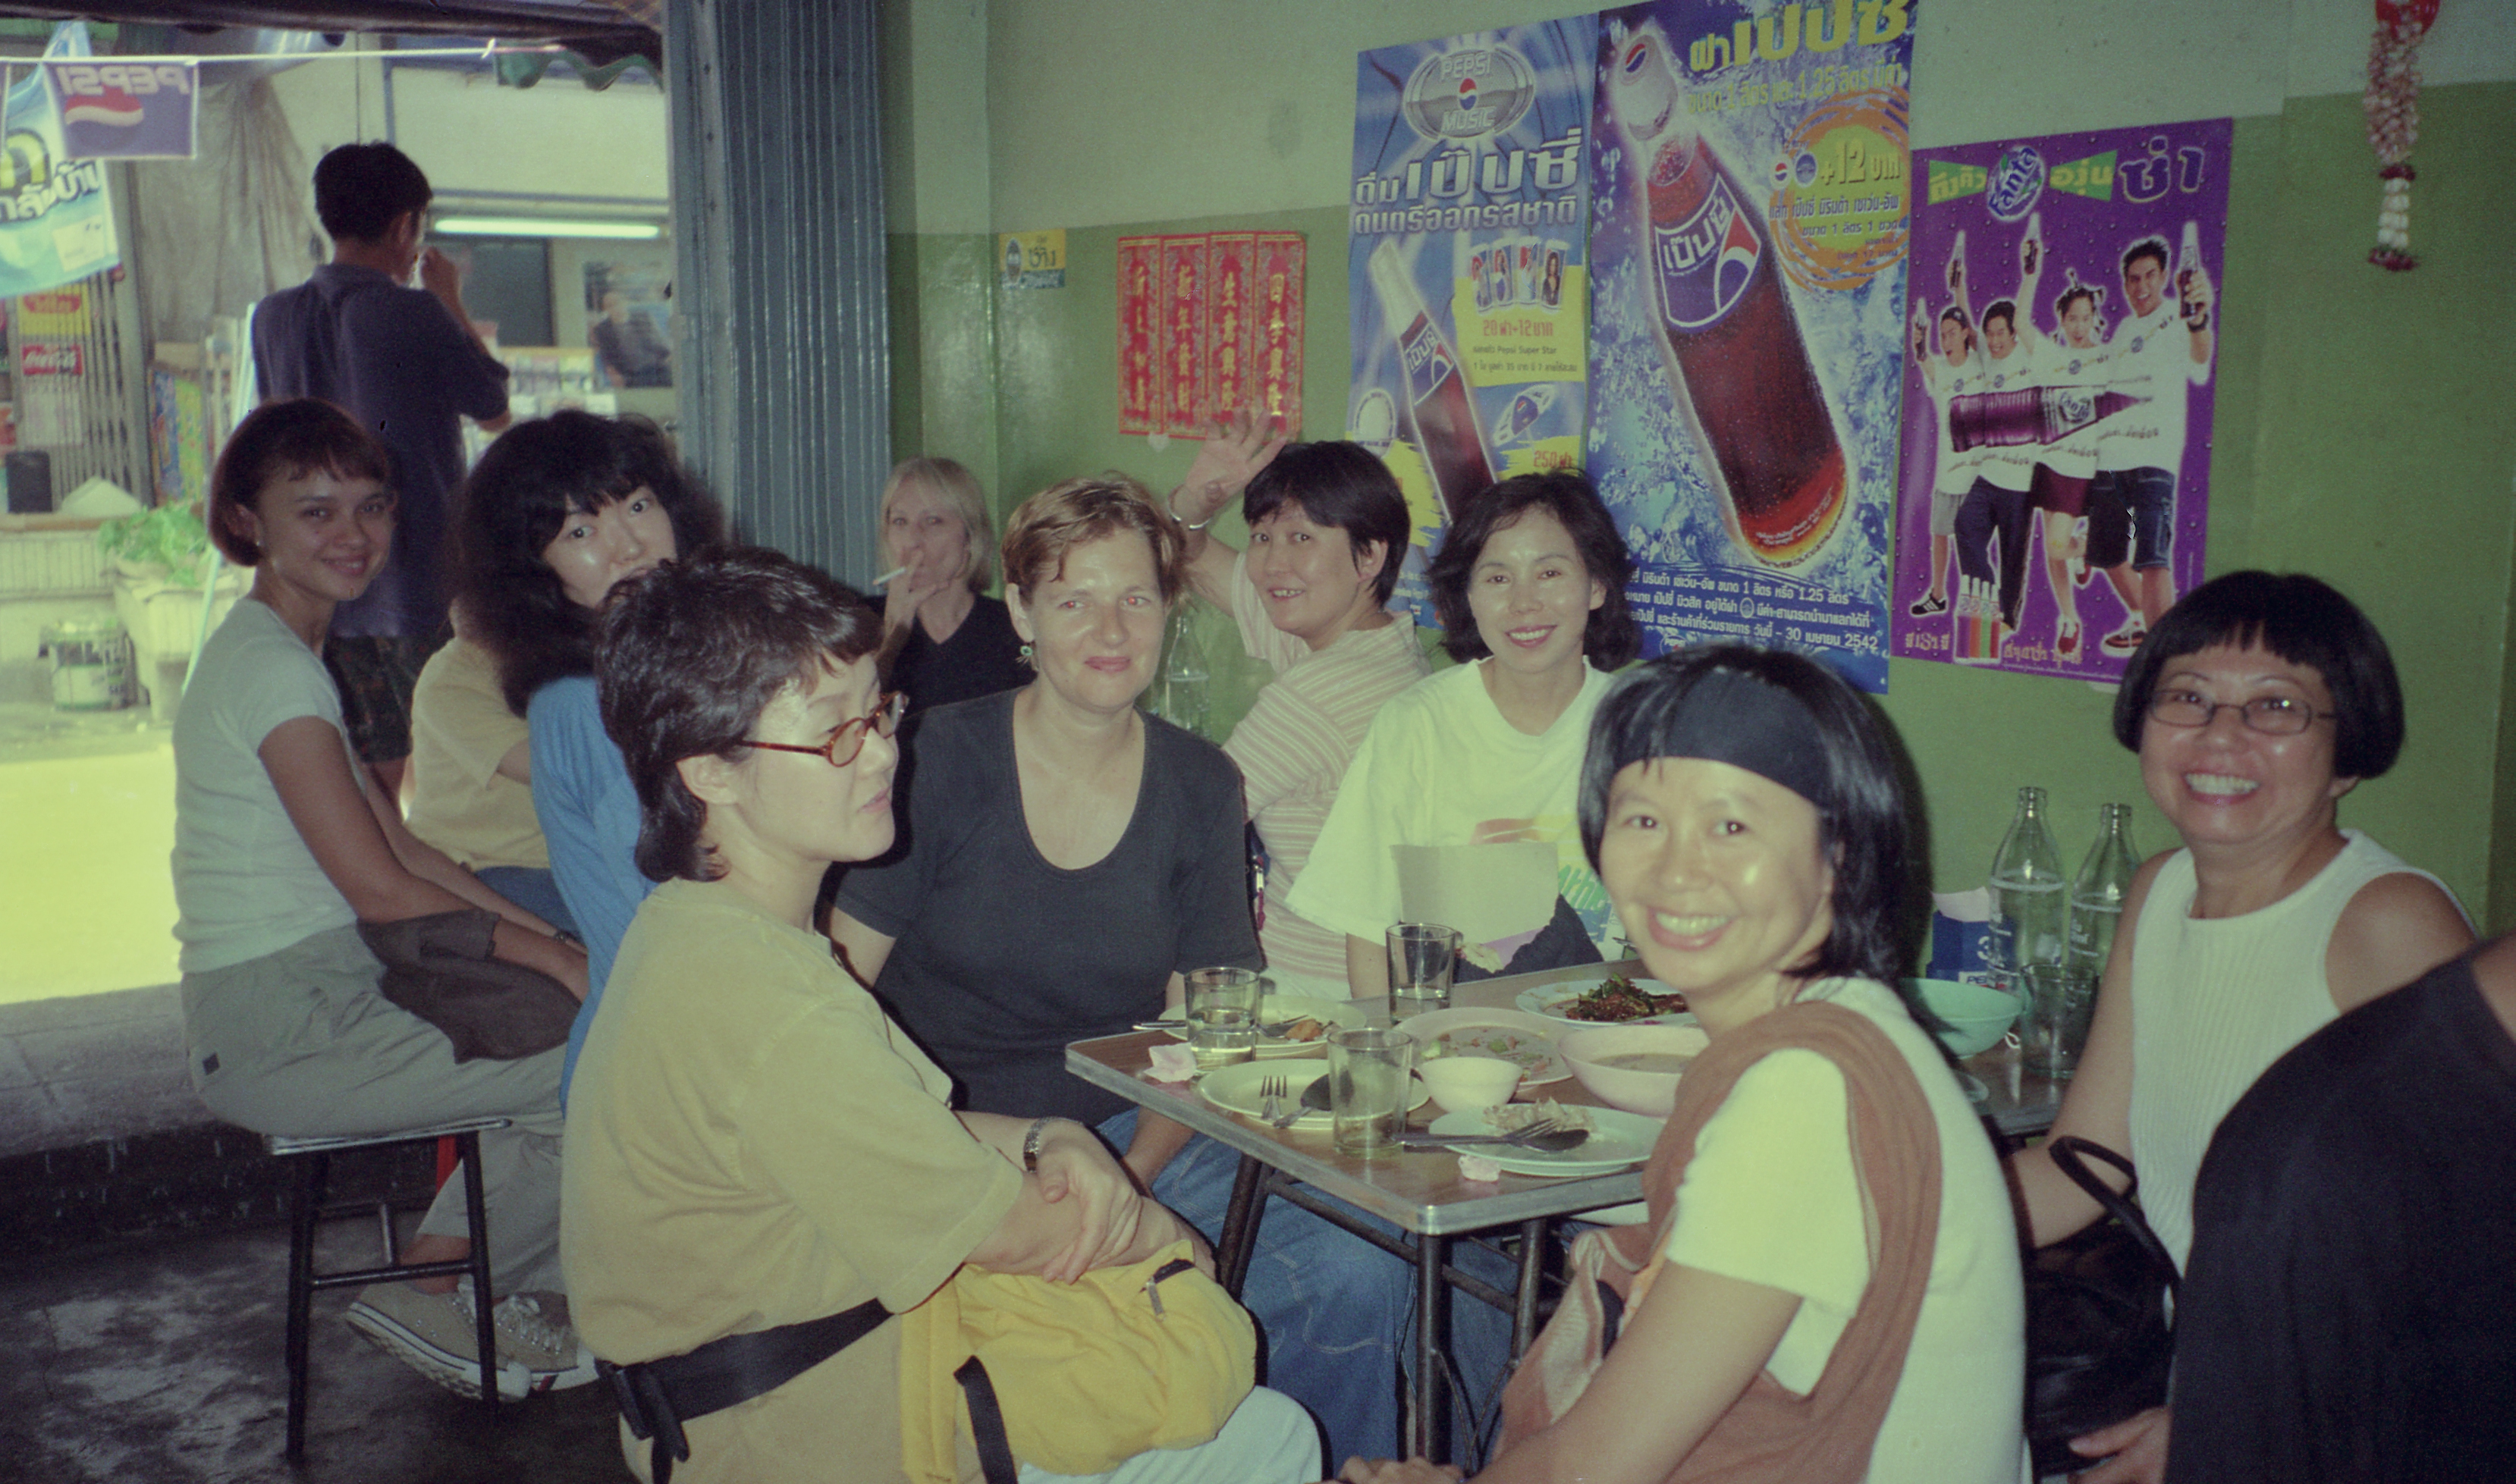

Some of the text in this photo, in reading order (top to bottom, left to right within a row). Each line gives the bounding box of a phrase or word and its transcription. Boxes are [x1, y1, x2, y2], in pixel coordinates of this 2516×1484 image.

[1440, 52, 1492, 80] PEPSI
[1727, 82, 1735, 109] 1
[1443, 106, 1497, 132] MUSIC
[1988, 146, 2038, 217] Fanta
[1534, 450, 1557, 468] 250
[1743, 581, 1749, 595] 1
[1798, 587, 1823, 603] 1.25
[1786, 627, 1801, 642] 30
[1845, 633, 1879, 651] 2542
